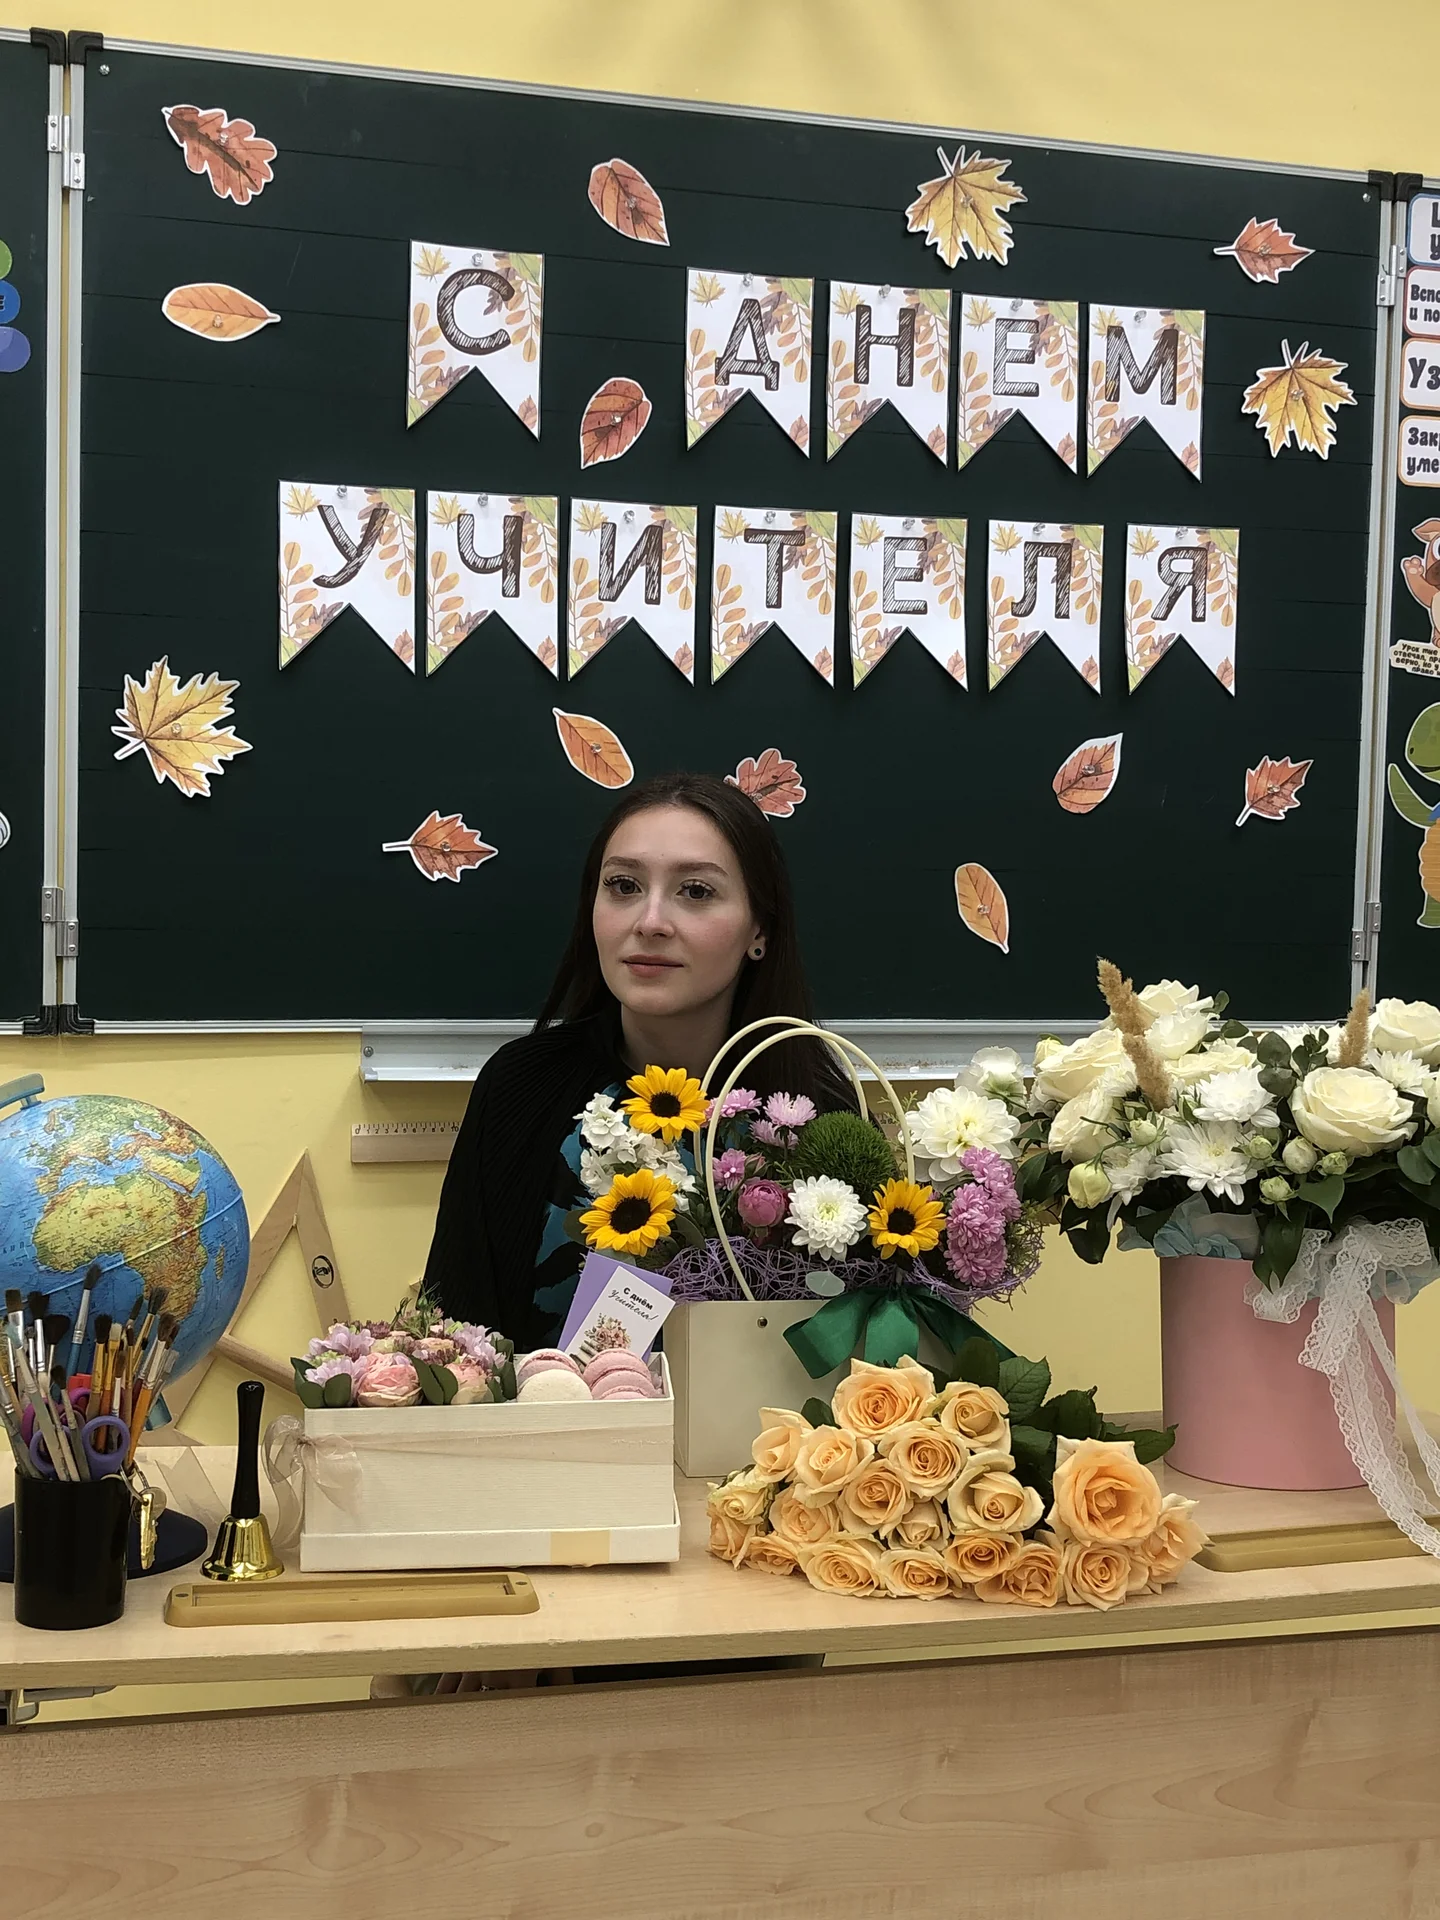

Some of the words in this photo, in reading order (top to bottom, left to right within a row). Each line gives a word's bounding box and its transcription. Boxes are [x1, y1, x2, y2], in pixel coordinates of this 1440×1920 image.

[1409, 307, 1418, 321] и
[437, 268, 515, 356] С
[714, 298, 1179, 406] ДНЕМ
[1408, 427, 1440, 452] Зак
[1406, 456, 1440, 476] уме
[312, 504, 1209, 622] УЧИТЕЛЯ
[1402, 643, 1420, 652] Урок
[623, 1287, 631, 1295] С
[630, 1293, 653, 1311] днём
